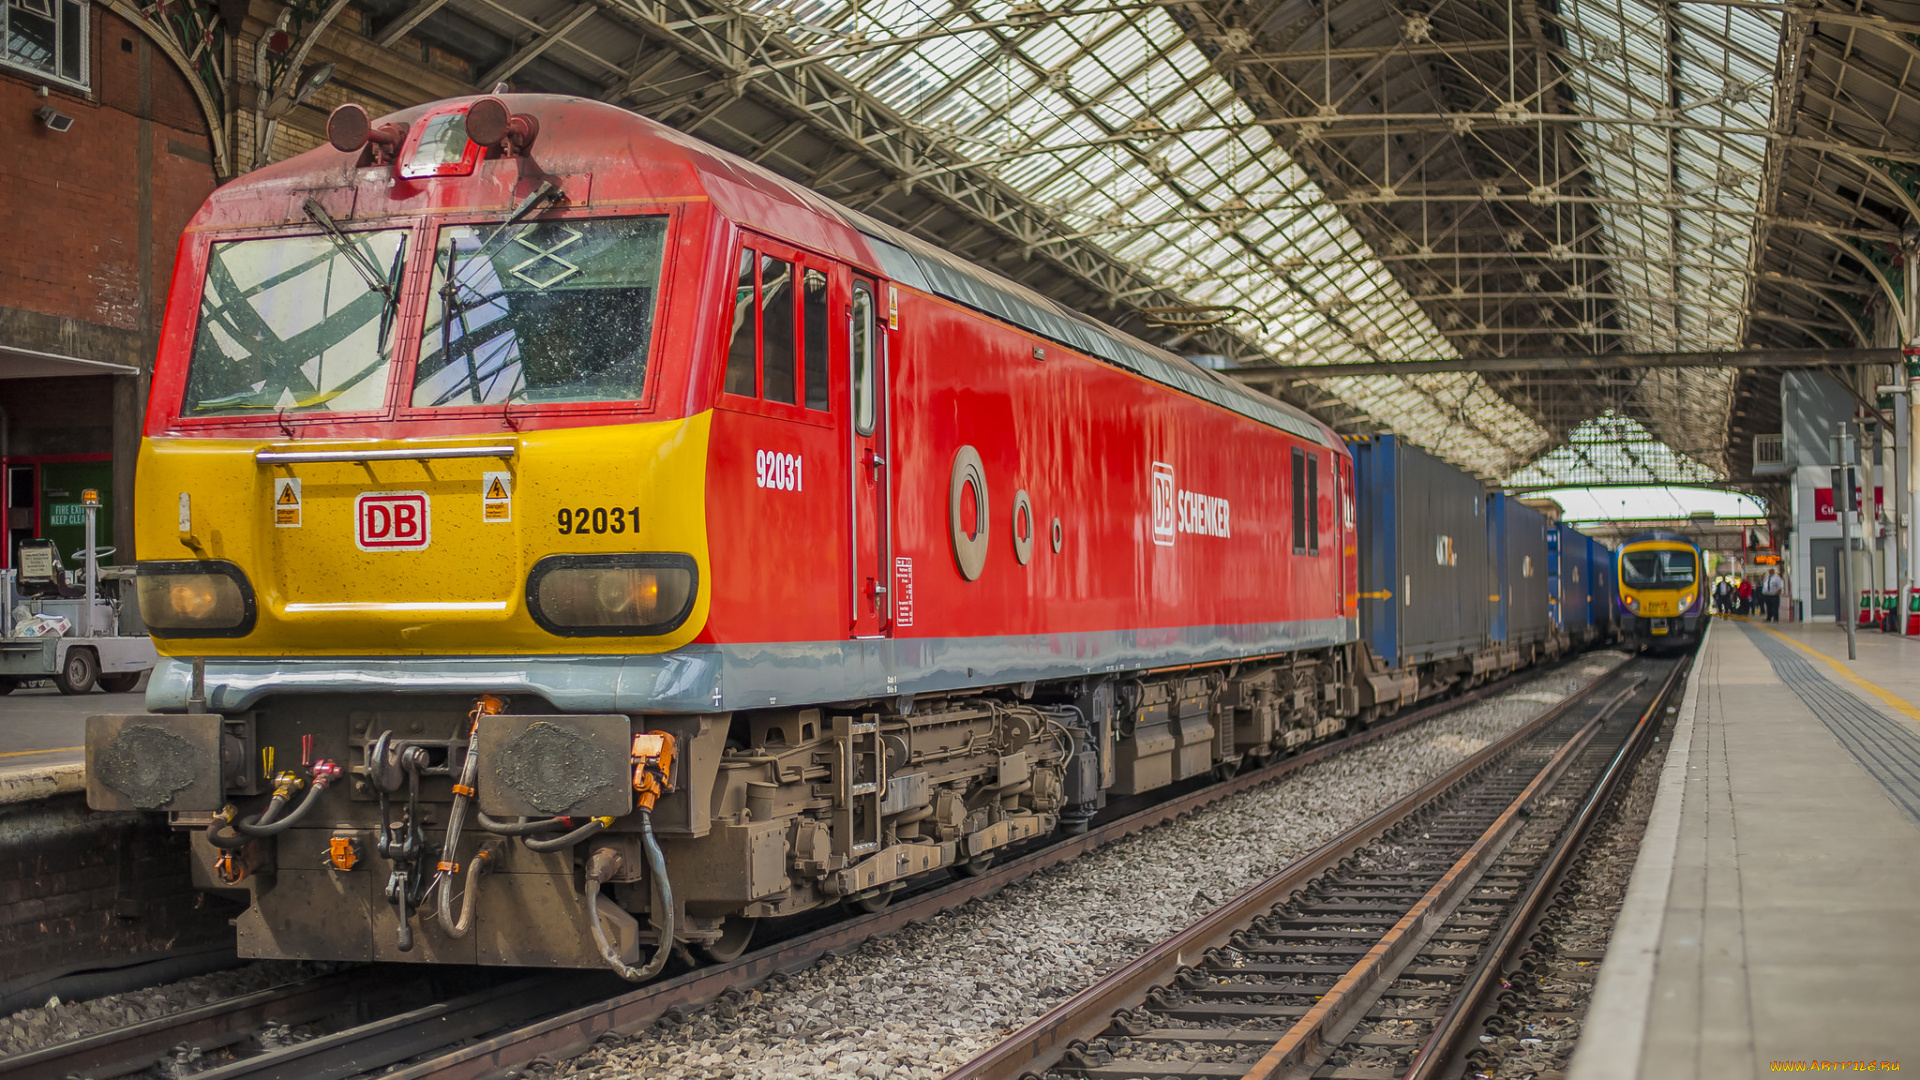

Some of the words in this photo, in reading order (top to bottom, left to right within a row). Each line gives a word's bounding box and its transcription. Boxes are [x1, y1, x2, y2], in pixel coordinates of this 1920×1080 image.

[756, 449, 803, 492] 92031
[51, 515, 68, 525] KEEP
[69, 514, 86, 525] CLEA
[55, 505, 69, 515] FIRE
[367, 503, 418, 539] DB
[557, 506, 641, 535] 92031
[1177, 488, 1231, 539] SCHENKER
[1821, 504, 1835, 516] Cu
